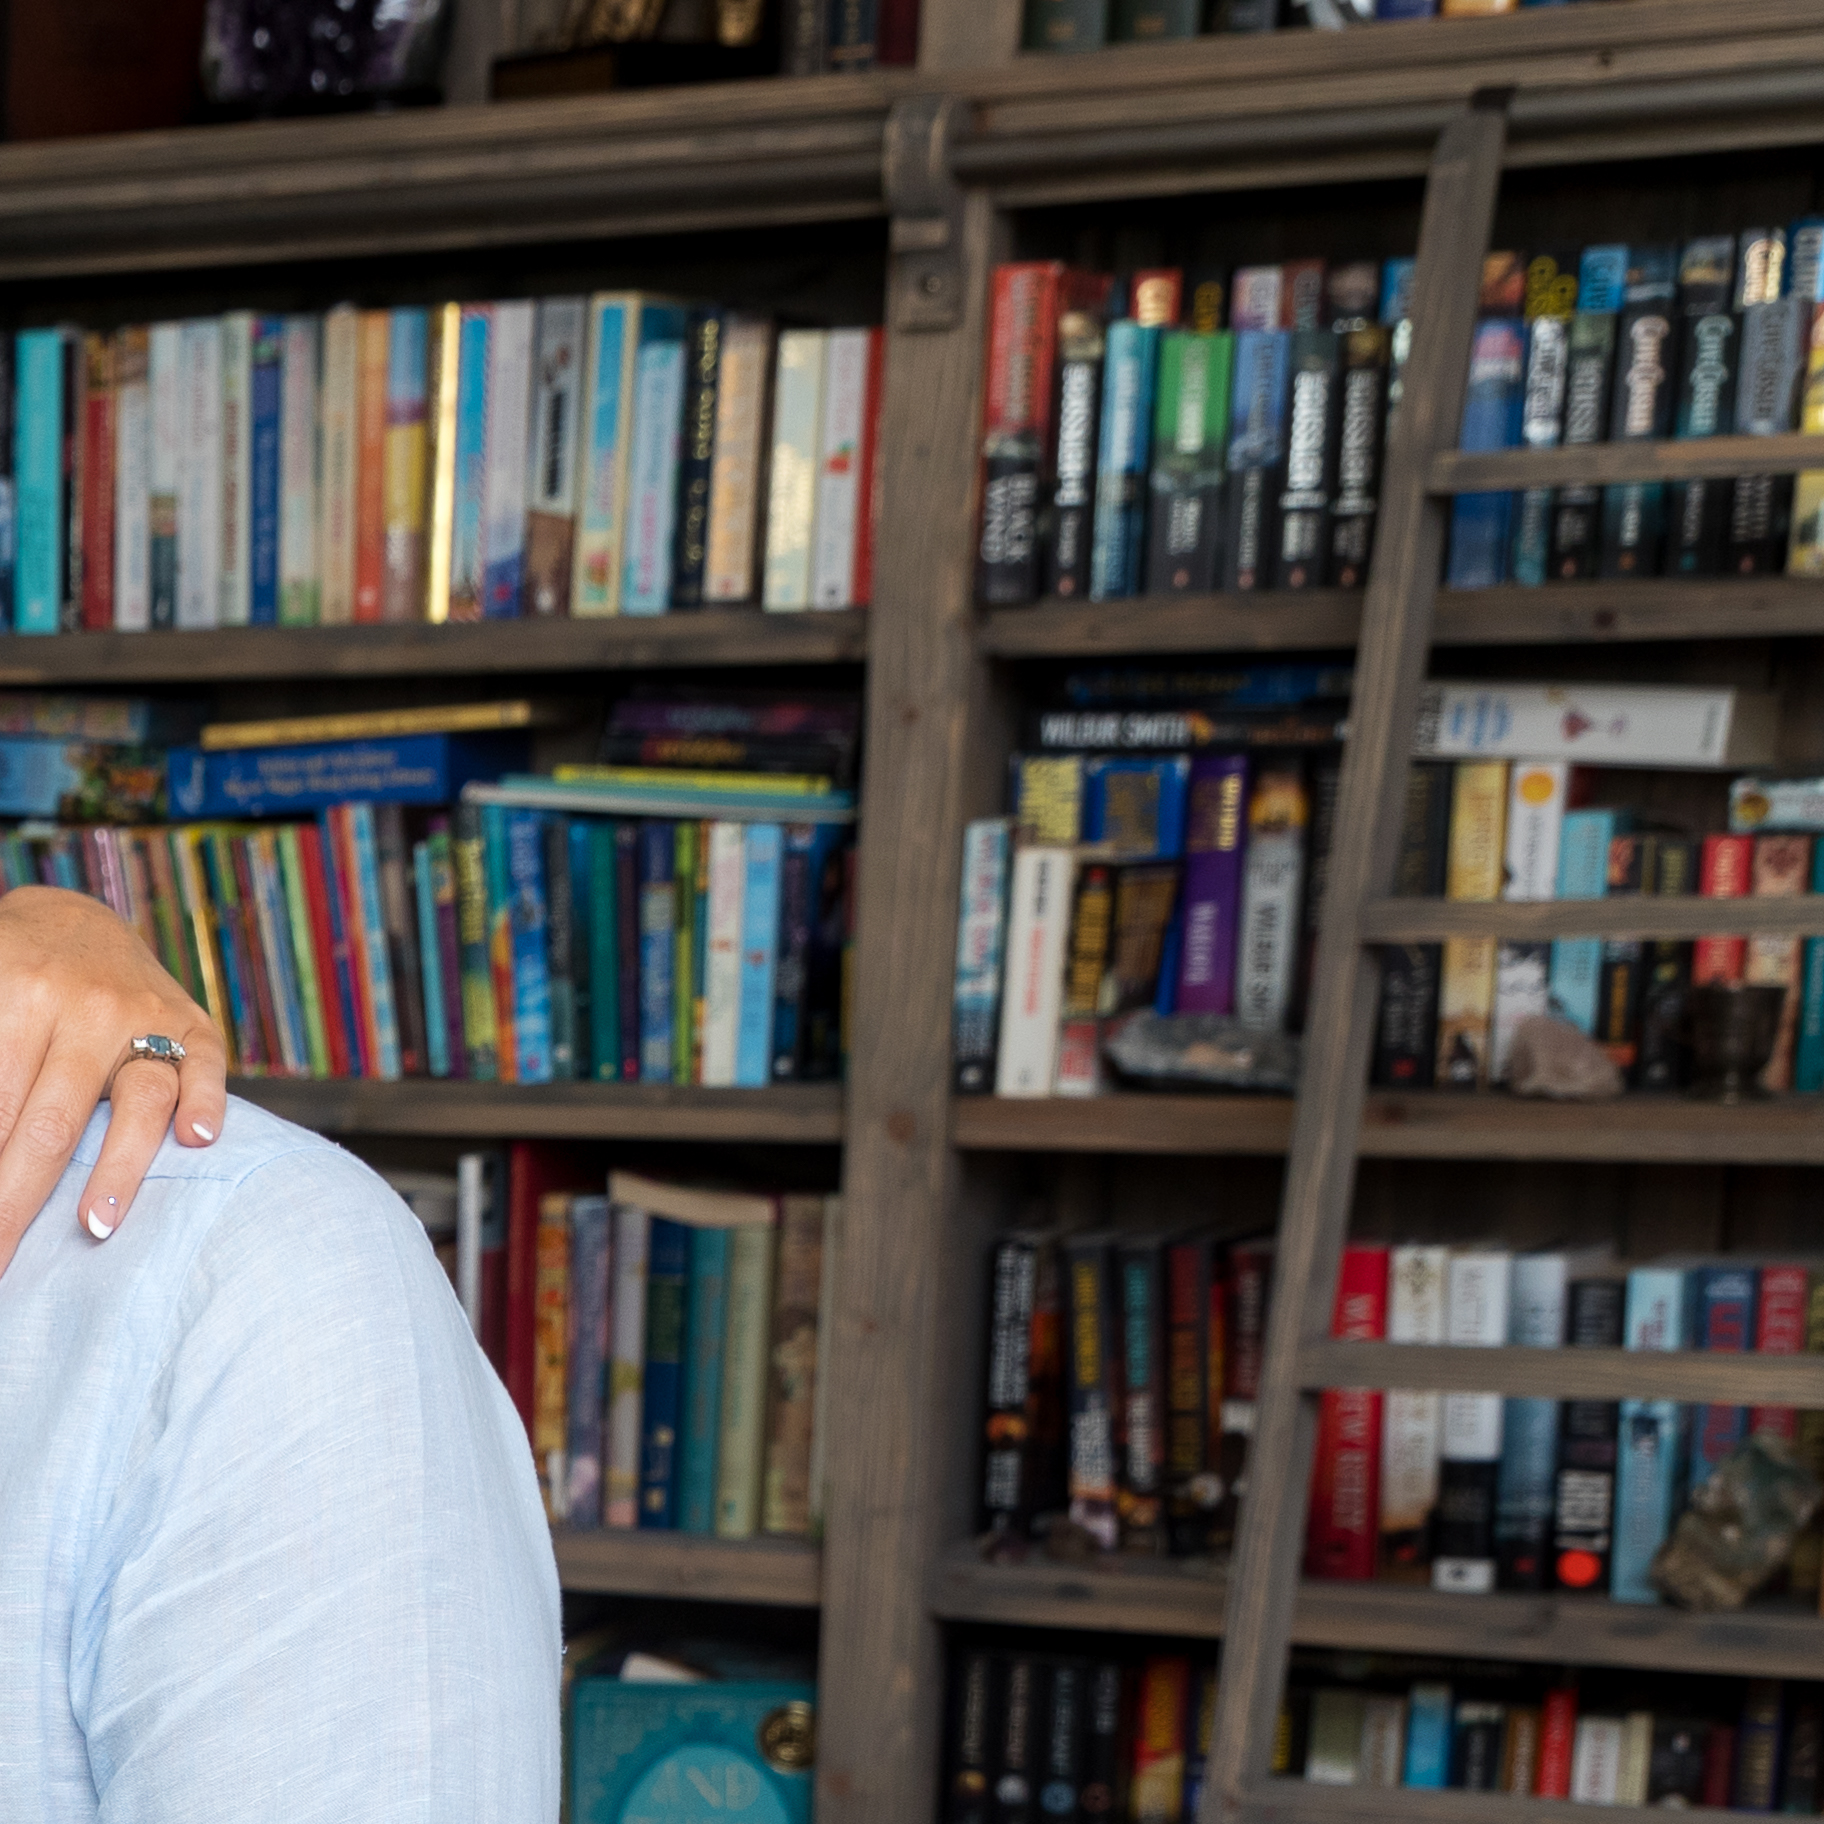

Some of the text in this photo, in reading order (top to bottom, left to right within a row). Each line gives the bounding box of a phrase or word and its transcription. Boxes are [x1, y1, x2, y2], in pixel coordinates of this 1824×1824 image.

[1040, 711, 1193, 747] WILBUR SMITH
[651, 1761, 760, 1810] AND
